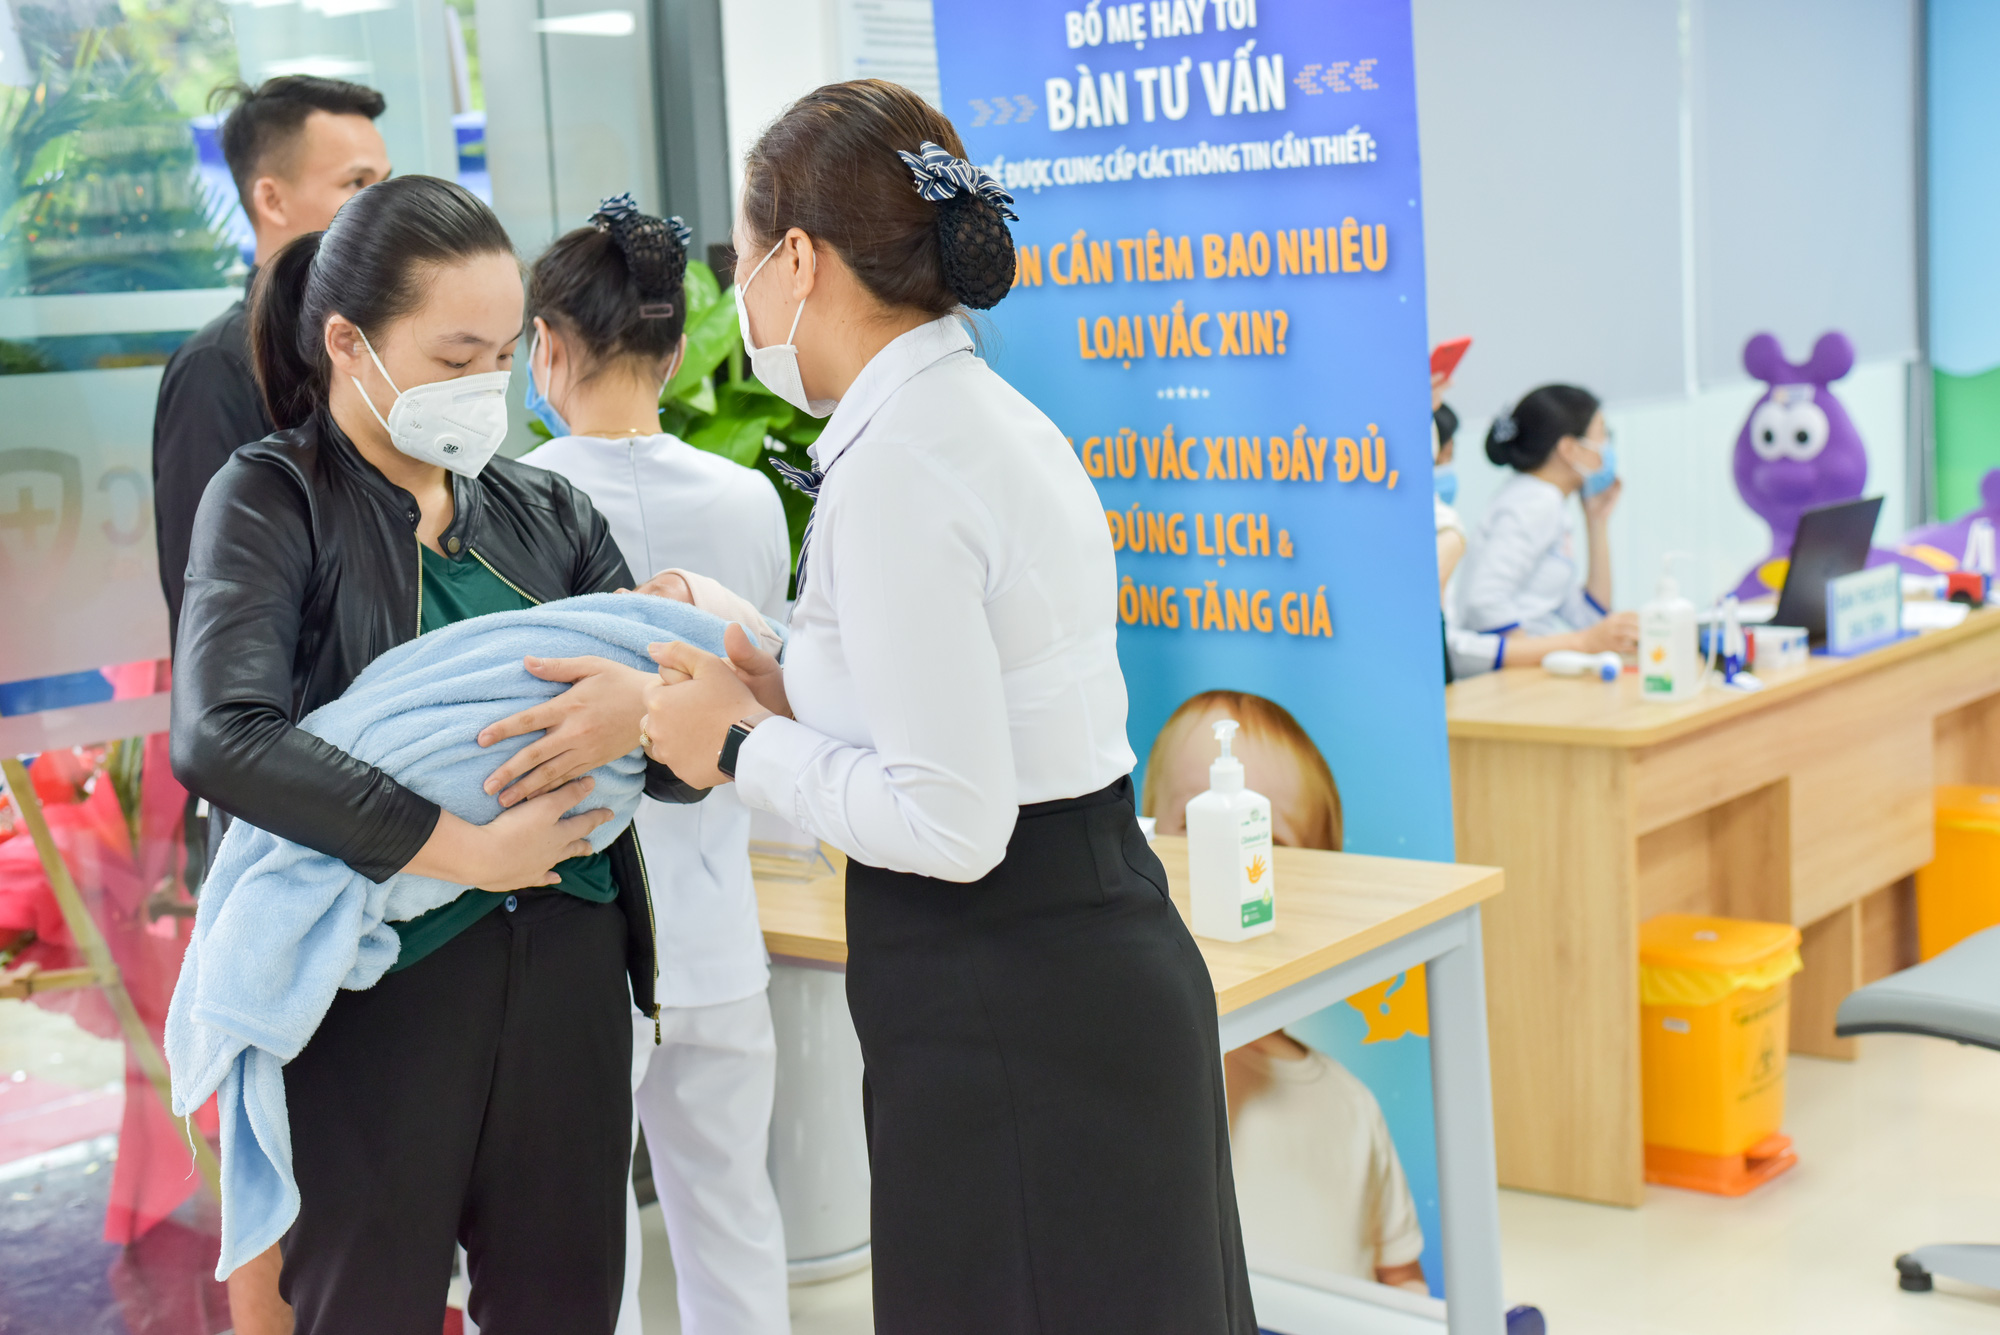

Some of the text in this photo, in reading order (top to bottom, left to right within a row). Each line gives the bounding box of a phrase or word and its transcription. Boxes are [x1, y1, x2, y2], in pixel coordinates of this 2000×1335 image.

[1065, 0, 1103, 49] BỐ
[1106, 2, 1147, 51] MẸ
[1045, 39, 1286, 131] BÀN TƯ VẤN
[1053, 154, 1104, 185] CUNG
[1104, 145, 1137, 182] CẤP
[1138, 144, 1172, 179] CÁC
[1172, 140, 1241, 176] THÔNG
[1239, 141, 1271, 171] TIN
[1310, 124, 1377, 166] THIẾT:
[1049, 229, 1113, 285] CẦN
[1117, 229, 1194, 282] TIÊM
[1202, 230, 1271, 279] BAO
[1277, 216, 1388, 275] NHIÊU
[1078, 300, 1289, 370] LOẠI VẮC XIN?
[1082, 423, 1399, 490] GIỮ VẮC XIN ĐẦY ĐỦ,
[1105, 502, 1293, 567] ĐÚNG LỊCH &
[1116, 575, 1333, 638] ÔNG TĂNG GIÁ
